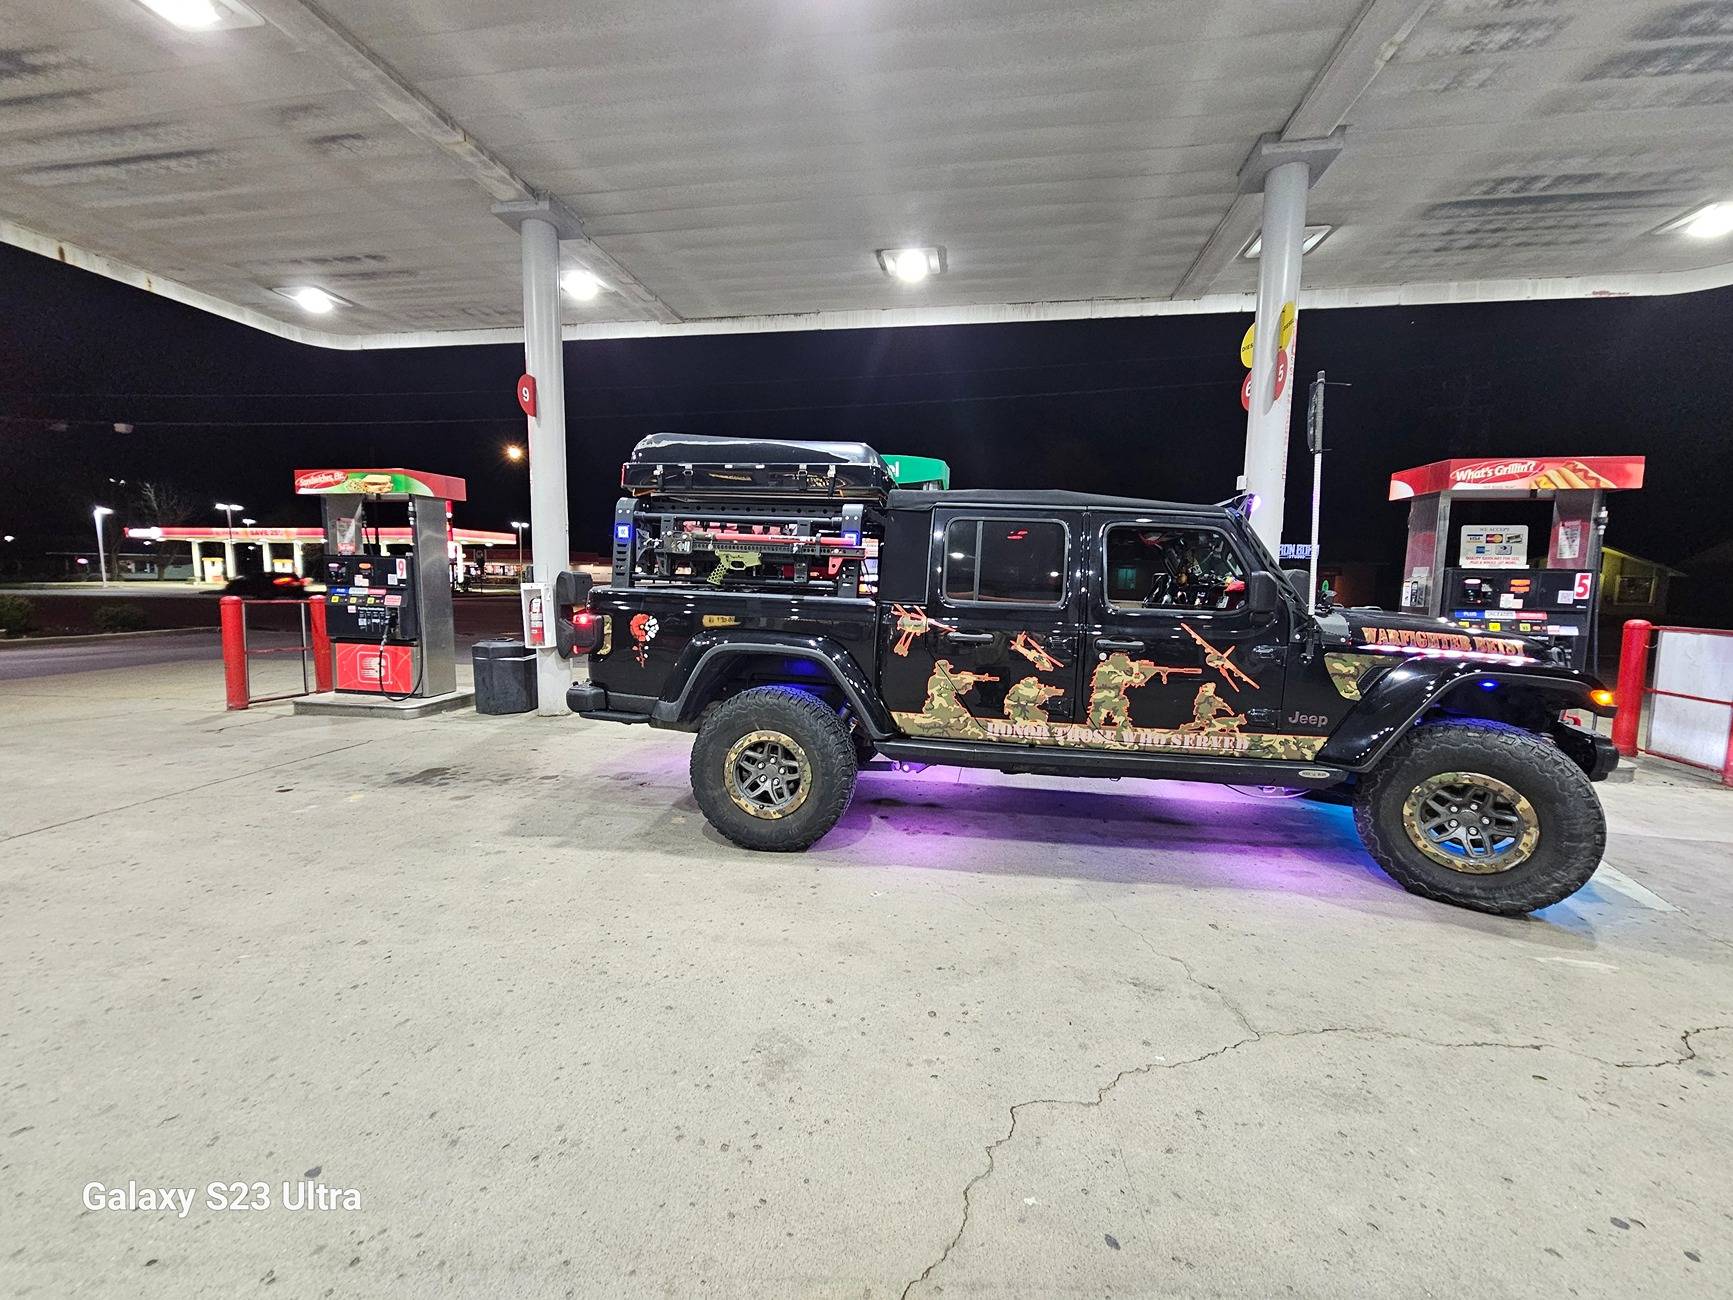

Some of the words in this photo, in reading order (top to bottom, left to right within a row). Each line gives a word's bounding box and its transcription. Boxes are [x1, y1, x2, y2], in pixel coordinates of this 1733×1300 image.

[1278, 364, 1284, 382] 5
[522, 387, 530, 402] 9
[1456, 466, 1493, 482] What's
[398, 560, 405, 577] 9
[1576, 575, 1589, 597] 5
[1288, 711, 1329, 728] Jeep
[986, 722, 1050, 739] HONOR
[1052, 727, 1118, 744] THOSE
[1121, 732, 1167, 746] WHO
[1170, 734, 1250, 750] SERVED
